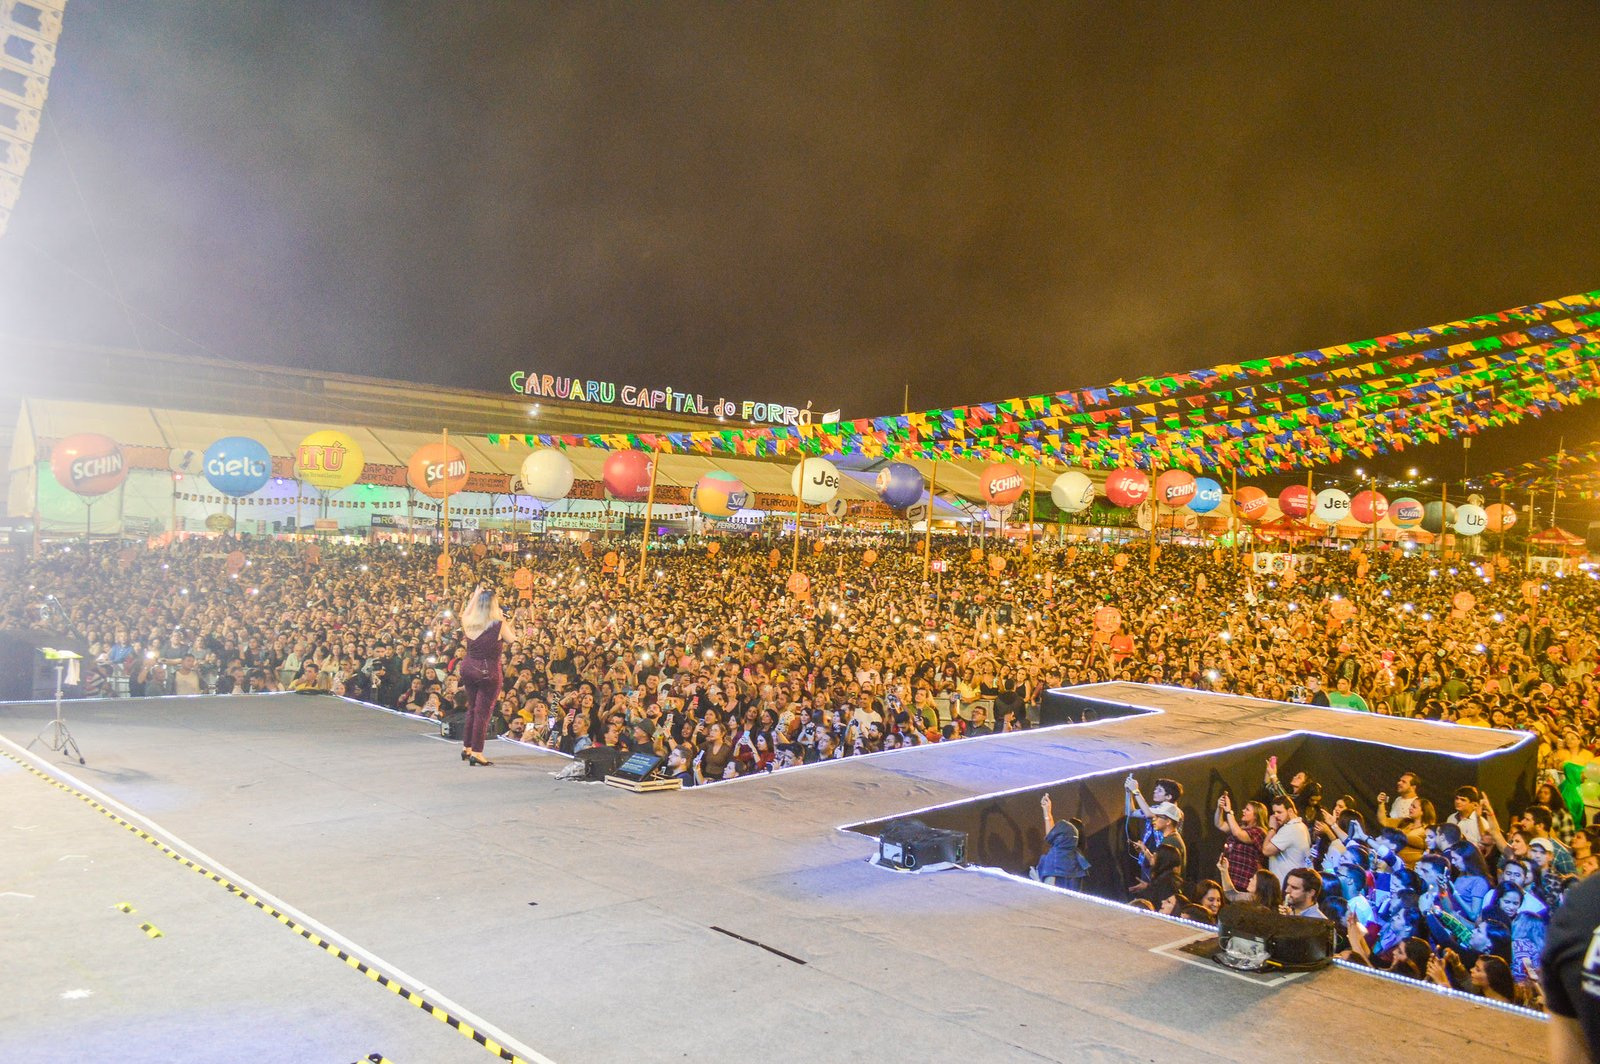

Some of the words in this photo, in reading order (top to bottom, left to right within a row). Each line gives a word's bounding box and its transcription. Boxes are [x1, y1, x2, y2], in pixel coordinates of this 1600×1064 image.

[510, 371, 615, 403] CARUARU
[713, 398, 736, 416] do
[742, 400, 812, 426] FORRÓ
[72, 453, 122, 479] SCHIN
[207, 452, 266, 478] cielo
[990, 475, 1020, 494] SCHIN
[1166, 482, 1195, 498] SCHIN
[1466, 514, 1486, 526] Ub
